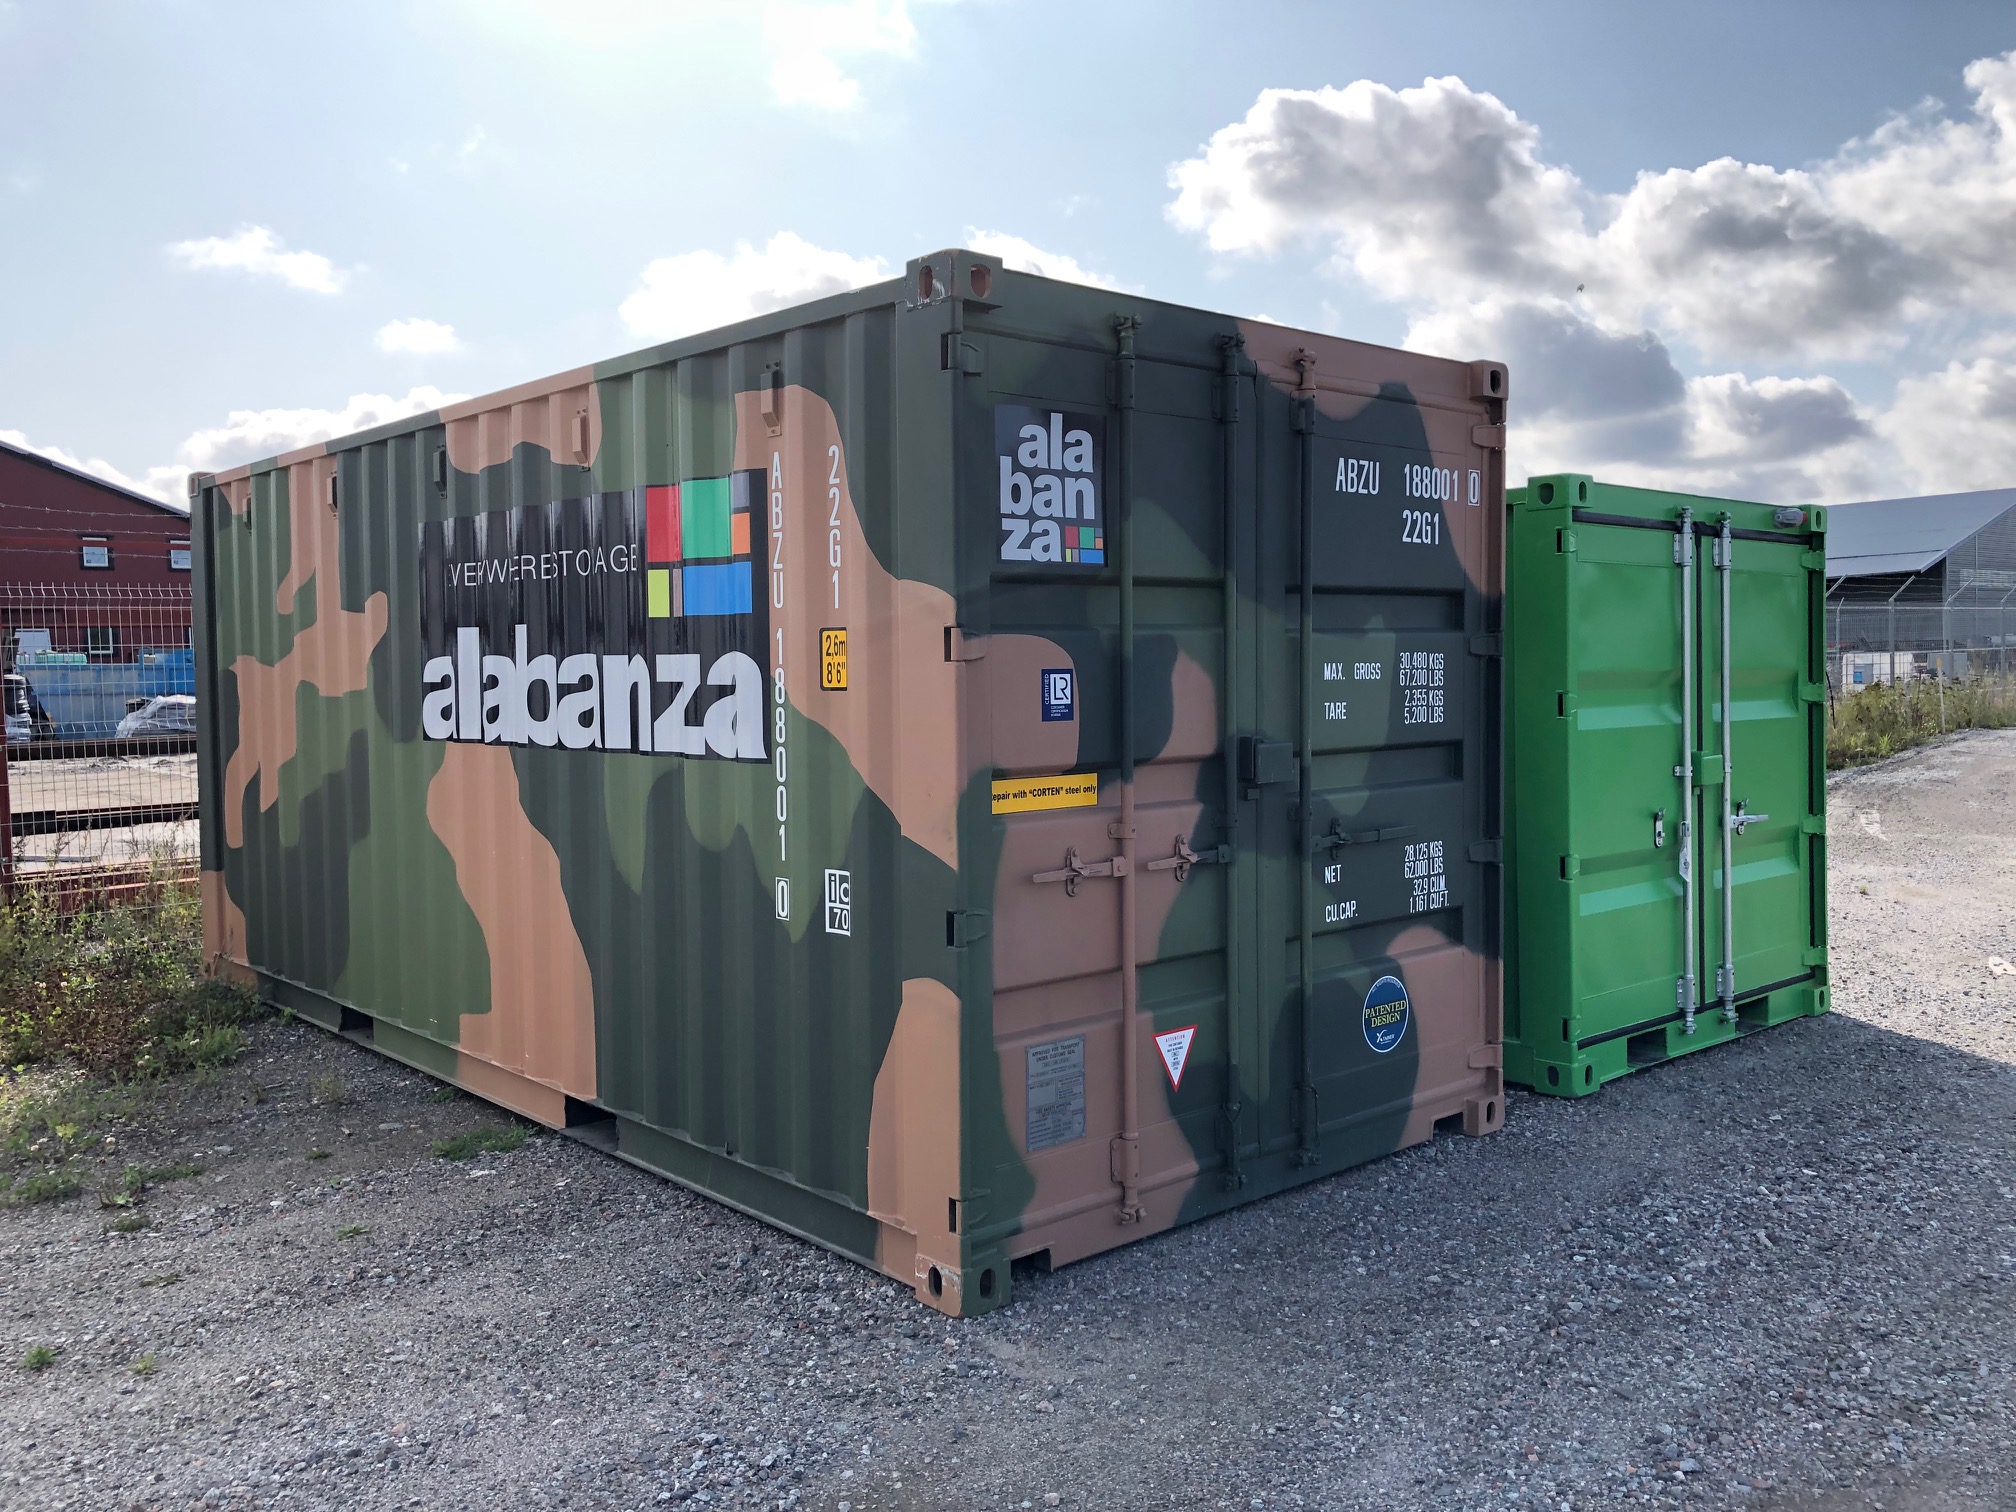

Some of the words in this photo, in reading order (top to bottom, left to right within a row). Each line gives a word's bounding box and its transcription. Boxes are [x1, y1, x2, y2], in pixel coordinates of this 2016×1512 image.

[1017, 412, 1094, 473] ala
[1000, 455, 1095, 520] ban
[1335, 457, 1380, 495] ABZU
[1404, 463, 1459, 502] 188001
[771, 451, 784, 609] ABZU
[828, 444, 842, 609] 22G1
[1402, 509, 1440, 545] 22G1
[1000, 518, 1063, 563] za
[1399, 651, 1428, 670] 30,480
[1429, 652, 1444, 669] KGS
[1323, 662, 1346, 681] MAX.
[1354, 662, 1381, 680] GROSS
[1399, 669, 1428, 687] 67,200
[1429, 669, 1444, 687] LBS
[422, 624, 768, 759] alabanza
[1404, 689, 1427, 707] 2,355
[1429, 689, 1444, 707] KGS
[1324, 702, 1347, 720] TARE
[1429, 706, 1444, 724] LBS
[774, 627, 787, 862] 188001
[992, 790, 1010, 803] epair
[1012, 789, 1028, 799] with
[1065, 784, 1082, 795] steel
[1083, 783, 1097, 795] only
[1404, 843, 1428, 862] 28,125
[1429, 840, 1443, 858] KGS
[1324, 864, 1342, 884] NET
[1429, 857, 1444, 875] LBS
[1409, 893, 1428, 914] 1,161
[833, 908, 849, 930] 70
[1365, 1000, 1407, 1018] PATENTED
[1371, 1011, 1401, 1028] DESIGN
